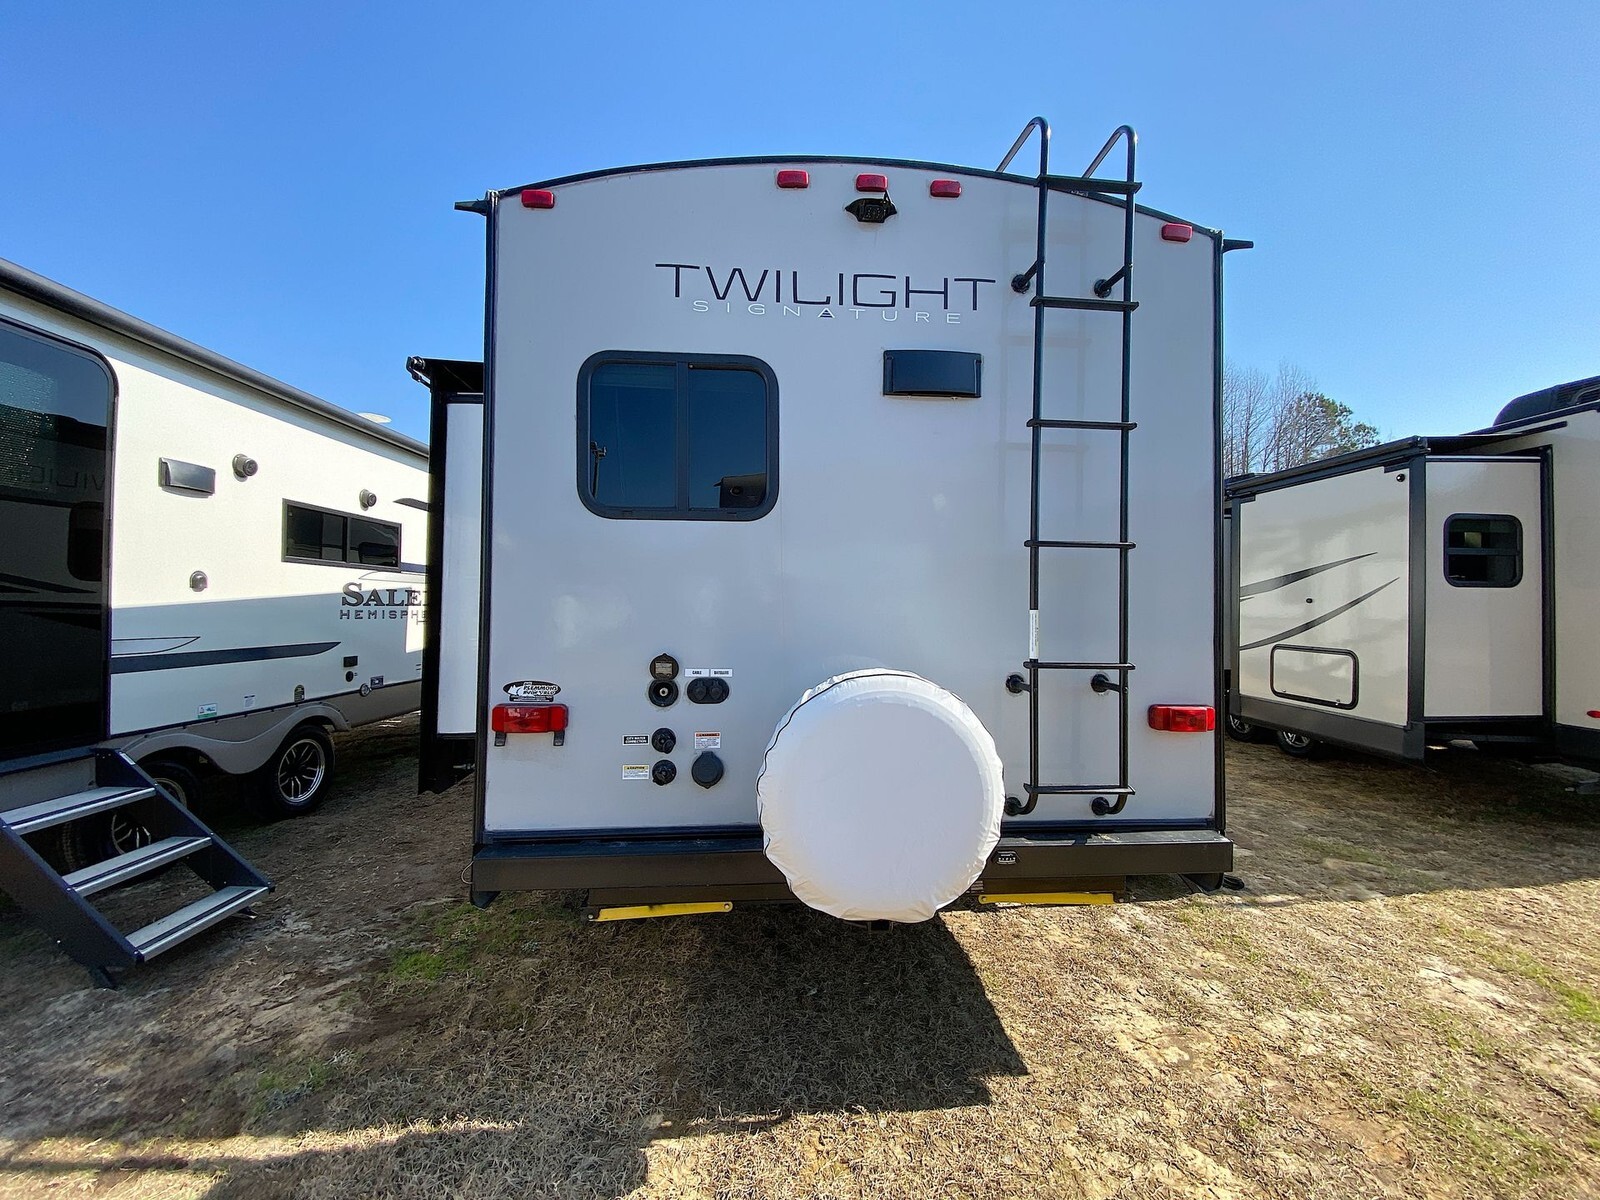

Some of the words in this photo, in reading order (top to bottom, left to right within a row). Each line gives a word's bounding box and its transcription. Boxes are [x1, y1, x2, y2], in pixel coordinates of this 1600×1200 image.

[655, 263, 996, 311] TWILIGHT
[692, 300, 961, 324] SIGNATURE
[341, 582, 427, 607] SALE
